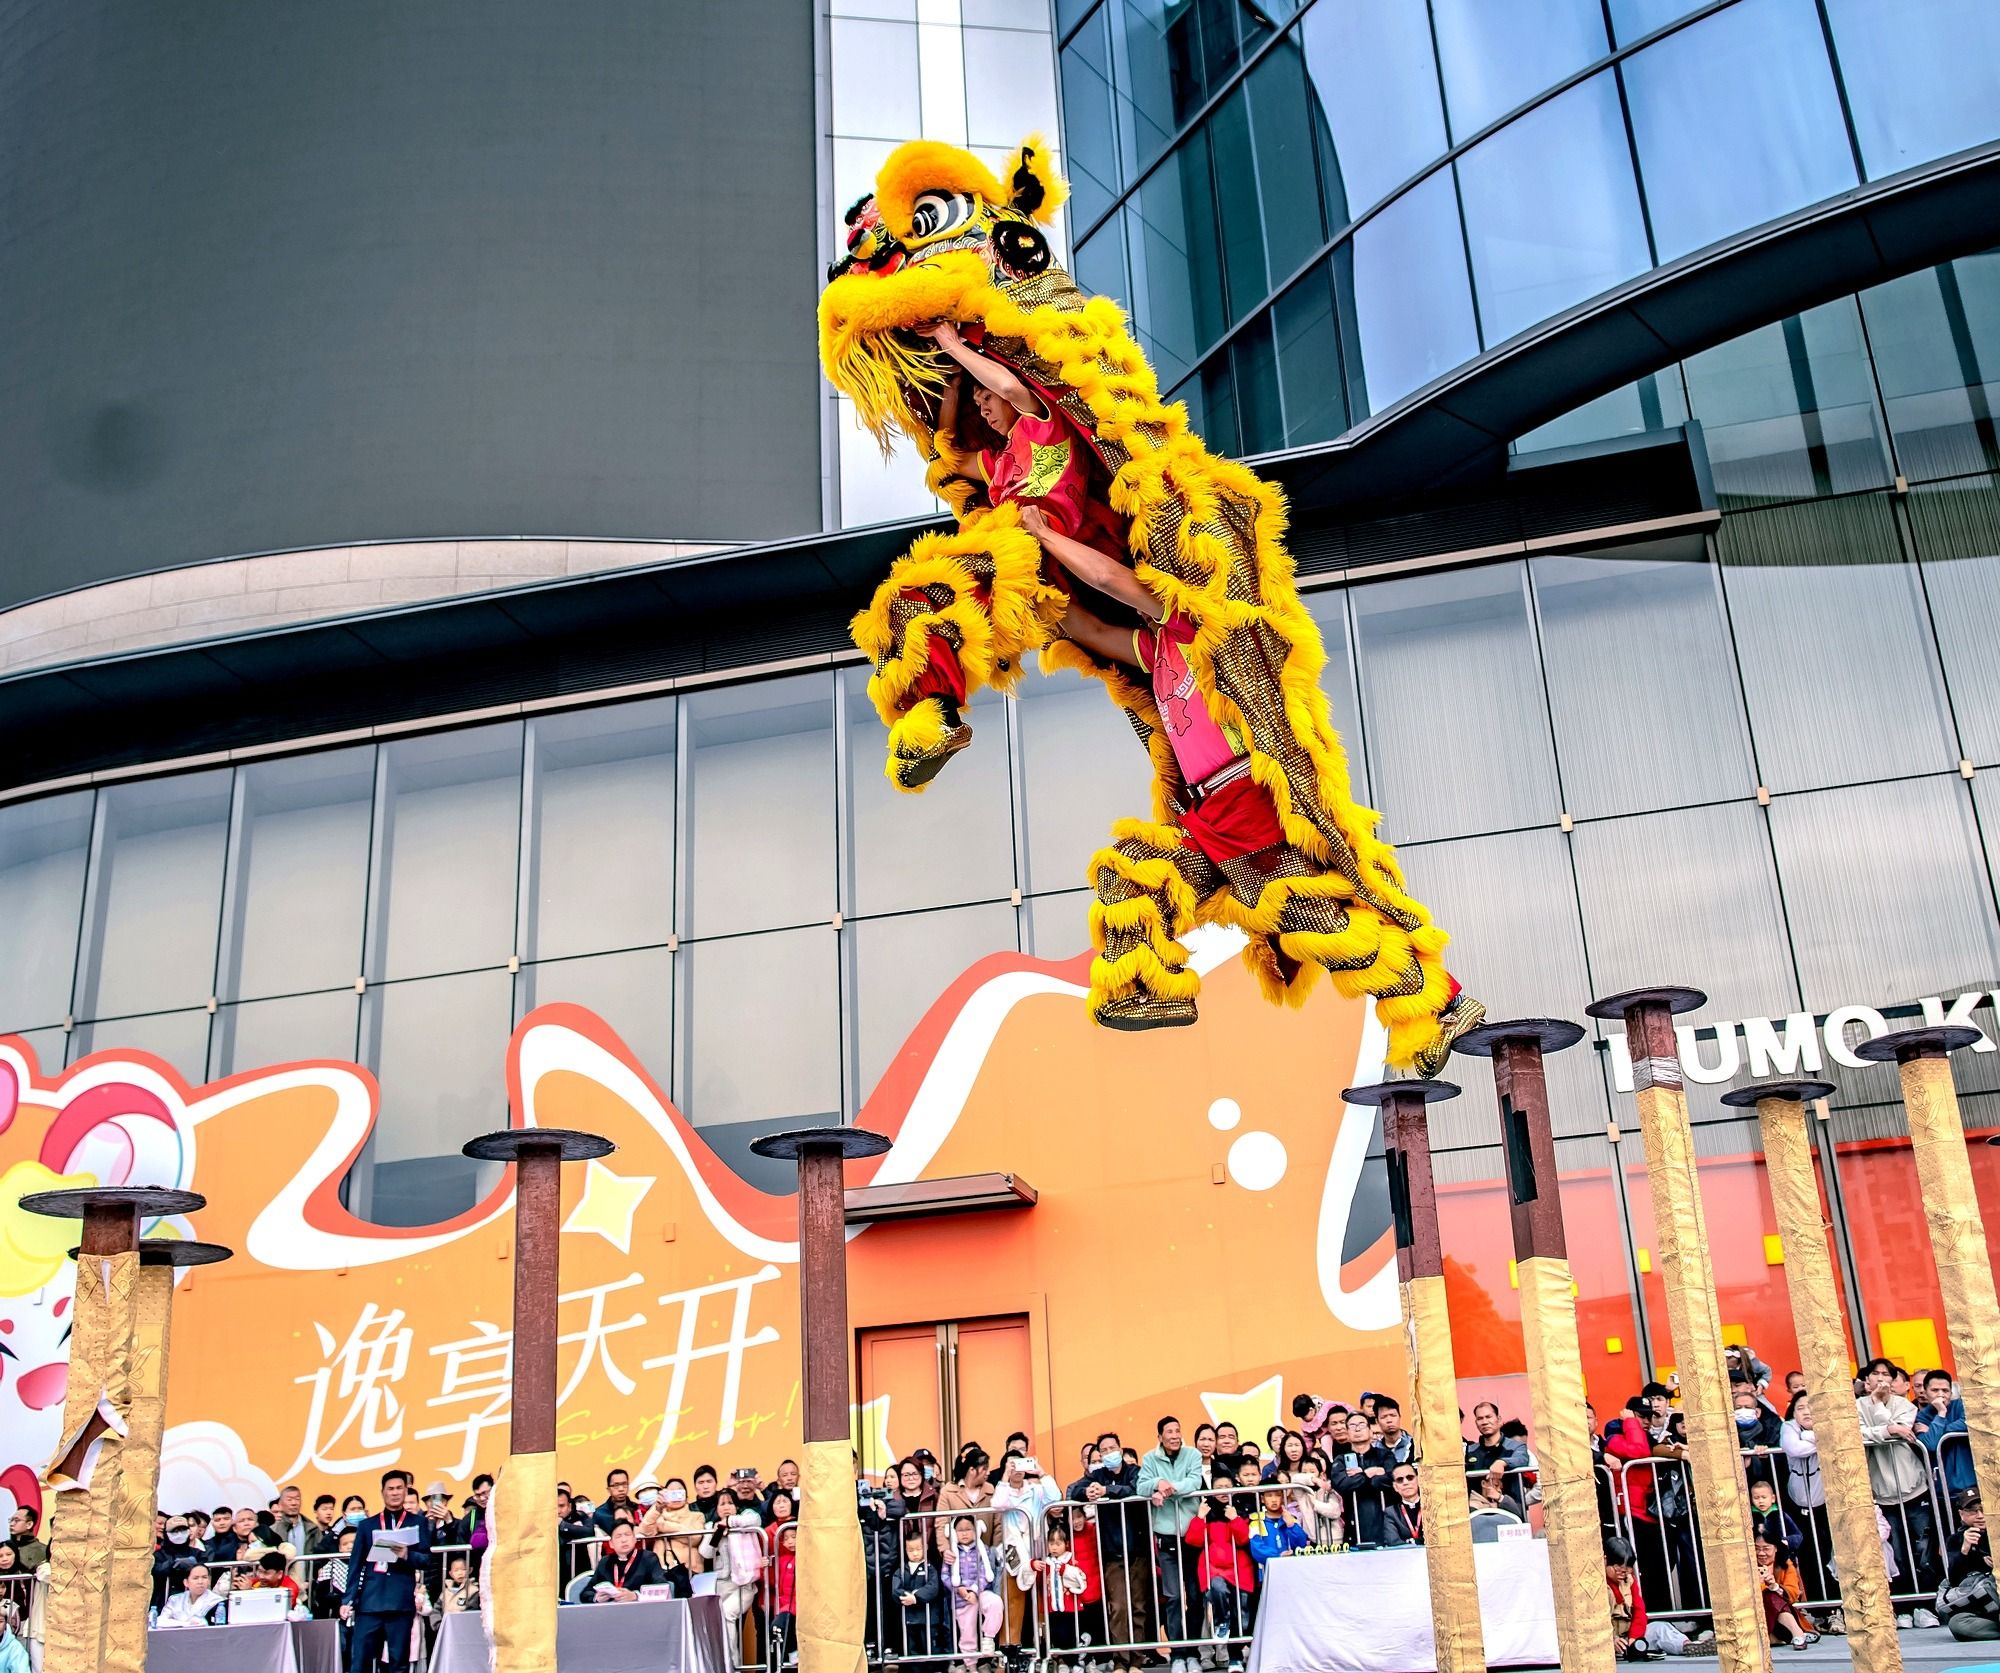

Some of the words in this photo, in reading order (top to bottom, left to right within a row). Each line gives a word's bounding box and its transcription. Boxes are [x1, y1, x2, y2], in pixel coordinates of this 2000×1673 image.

[1917, 987, 2000, 1054] K
[275, 1264, 782, 1492] 逸享天开
[718, 1379, 801, 1439] op!
